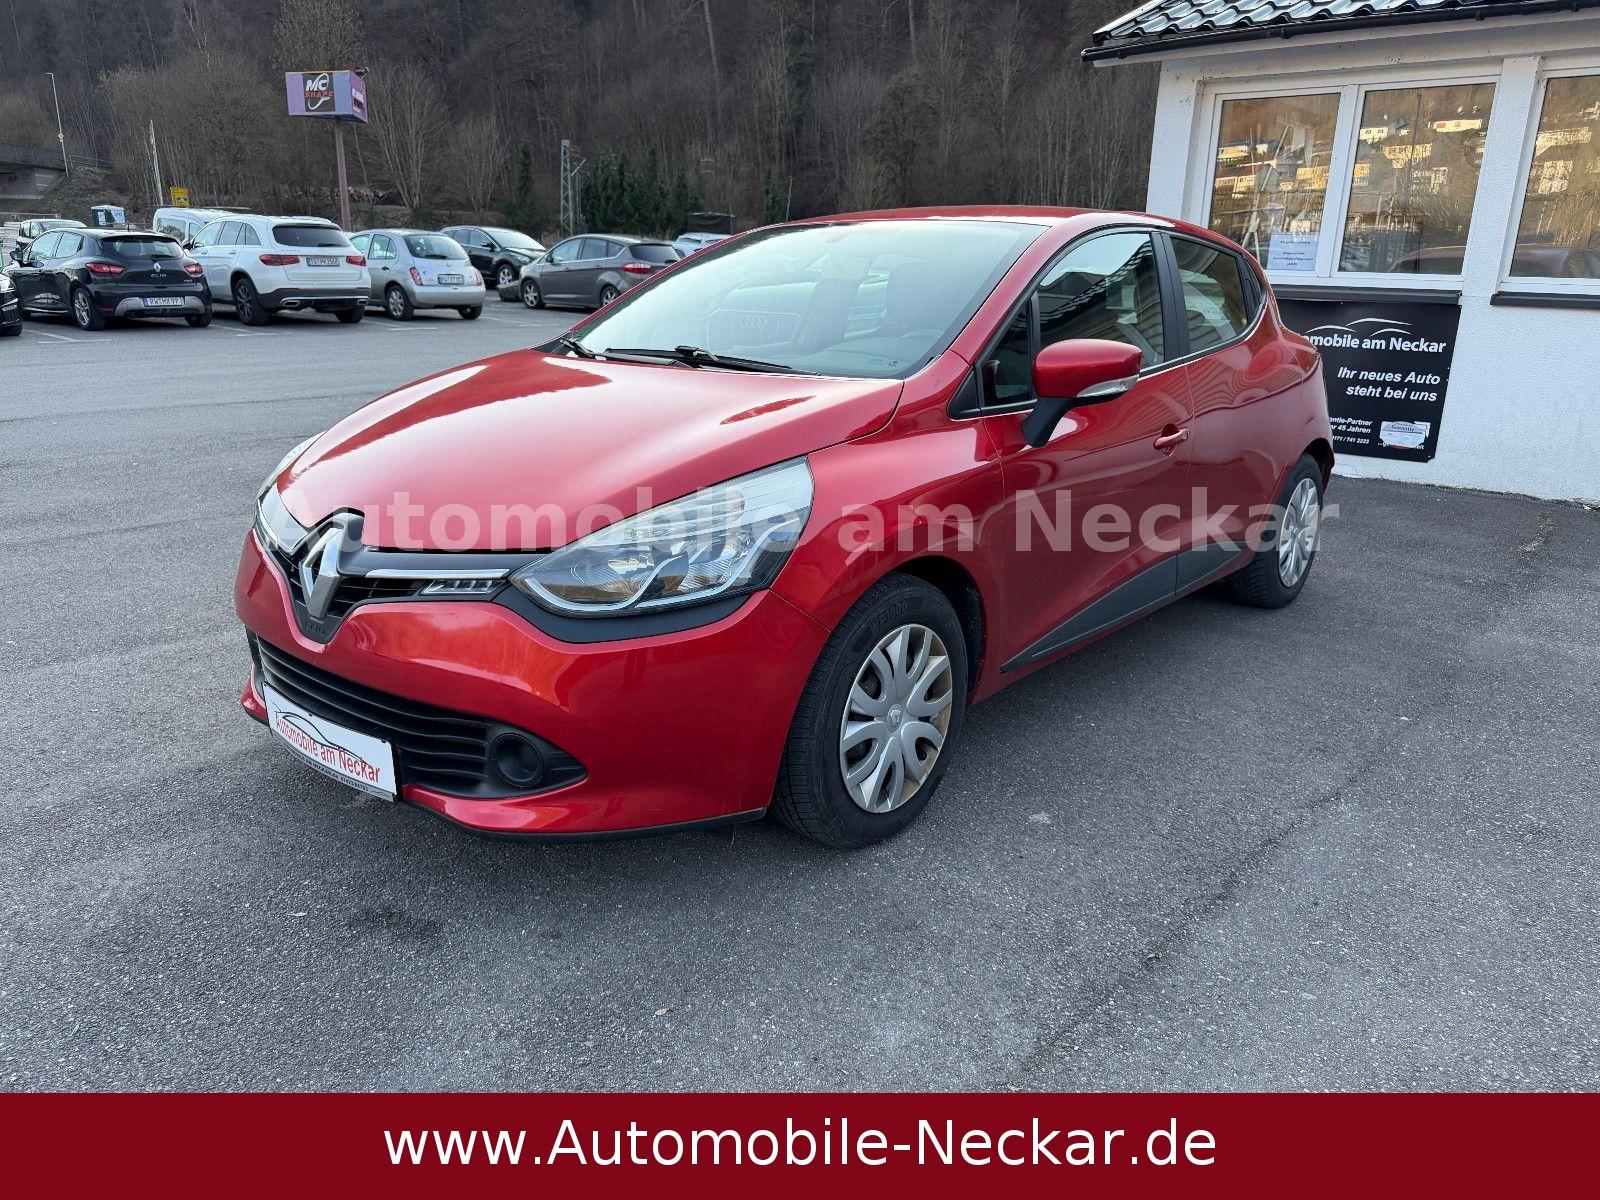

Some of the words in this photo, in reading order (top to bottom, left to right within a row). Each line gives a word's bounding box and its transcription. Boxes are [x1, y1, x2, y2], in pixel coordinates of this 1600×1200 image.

[1303, 333, 1360, 348] mobile
[1361, 338, 1387, 350] am
[1389, 337, 1447, 353] Neckar
[1337, 366, 1358, 379] Ihr
[1359, 370, 1402, 383] neues
[1404, 371, 1441, 385] Auto
[1345, 384, 1382, 398] steht
[1384, 386, 1408, 399] bei
[1409, 390, 1438, 402] uns
[1330, 416, 1373, 426] antie-Partner
[1347, 425, 1371, 434] Jahren
[276, 713, 318, 757] Automobile
[320, 744, 337, 767] am
[338, 748, 381, 783] Neckar
